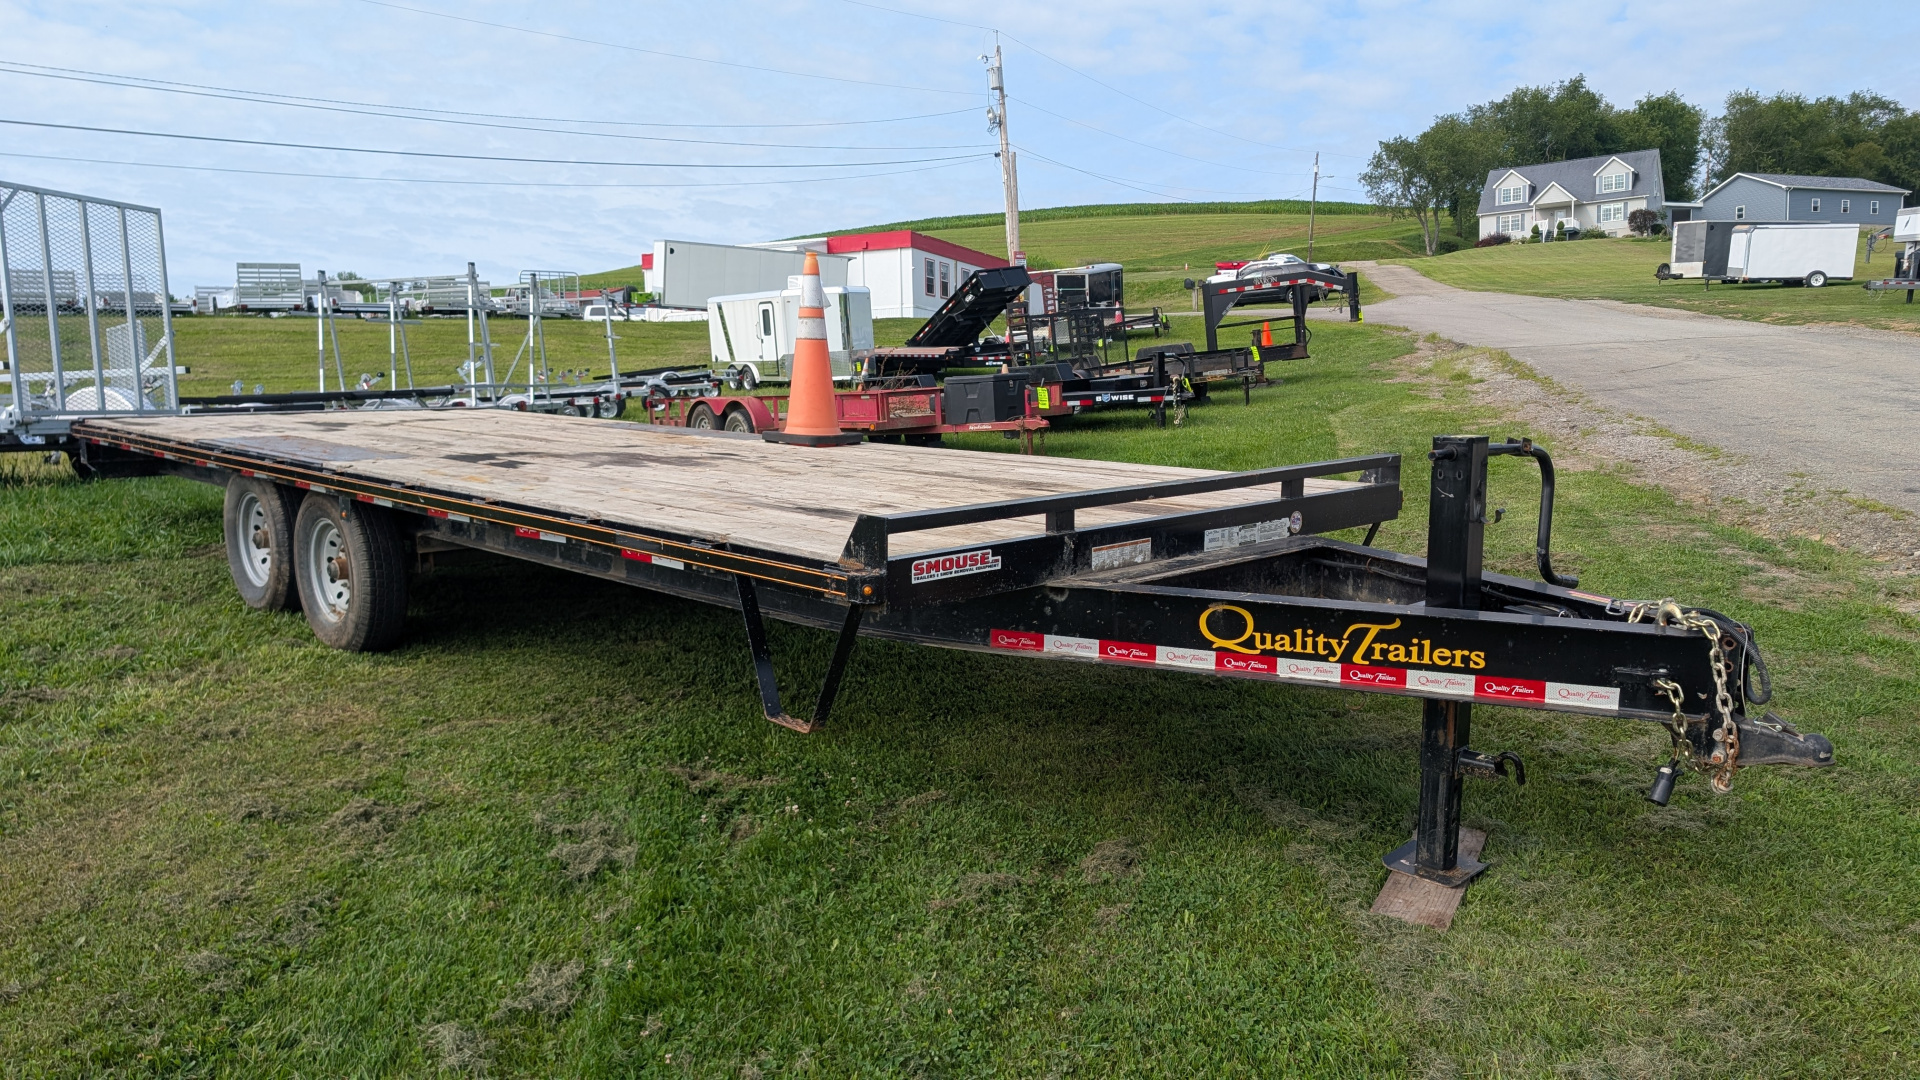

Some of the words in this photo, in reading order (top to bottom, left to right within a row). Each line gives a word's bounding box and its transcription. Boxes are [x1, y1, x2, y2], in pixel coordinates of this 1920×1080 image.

[914, 573, 936, 581] TRAILERS
[998, 634, 1018, 645] Quality
[1018, 637, 1036, 646] Trailers
[1199, 604, 1349, 661] Quality
[1343, 618, 1486, 669] Trailers
[1053, 640, 1074, 650] Quality
[1074, 642, 1093, 651] Trailers
[1107, 645, 1129, 656] Quality
[1128, 648, 1149, 658] Trailers
[1166, 651, 1189, 661] Quality
[1189, 654, 1208, 664] Trailers
[1224, 657, 1246, 668] Quality
[1246, 660, 1268, 670] Trailers
[1288, 663, 1312, 674] Quality
[1312, 666, 1334, 676] Trailers
[1349, 670, 1374, 682] Quality
[1374, 672, 1396, 684] Trailers
[1417, 675, 1443, 688] Quality
[1443, 678, 1466, 689] Trailers
[1484, 681, 1510, 694] Quality
[1511, 685, 1535, 697] Trailers
[1558, 688, 1585, 700] Quality
[1585, 691, 1611, 702] Trailers
